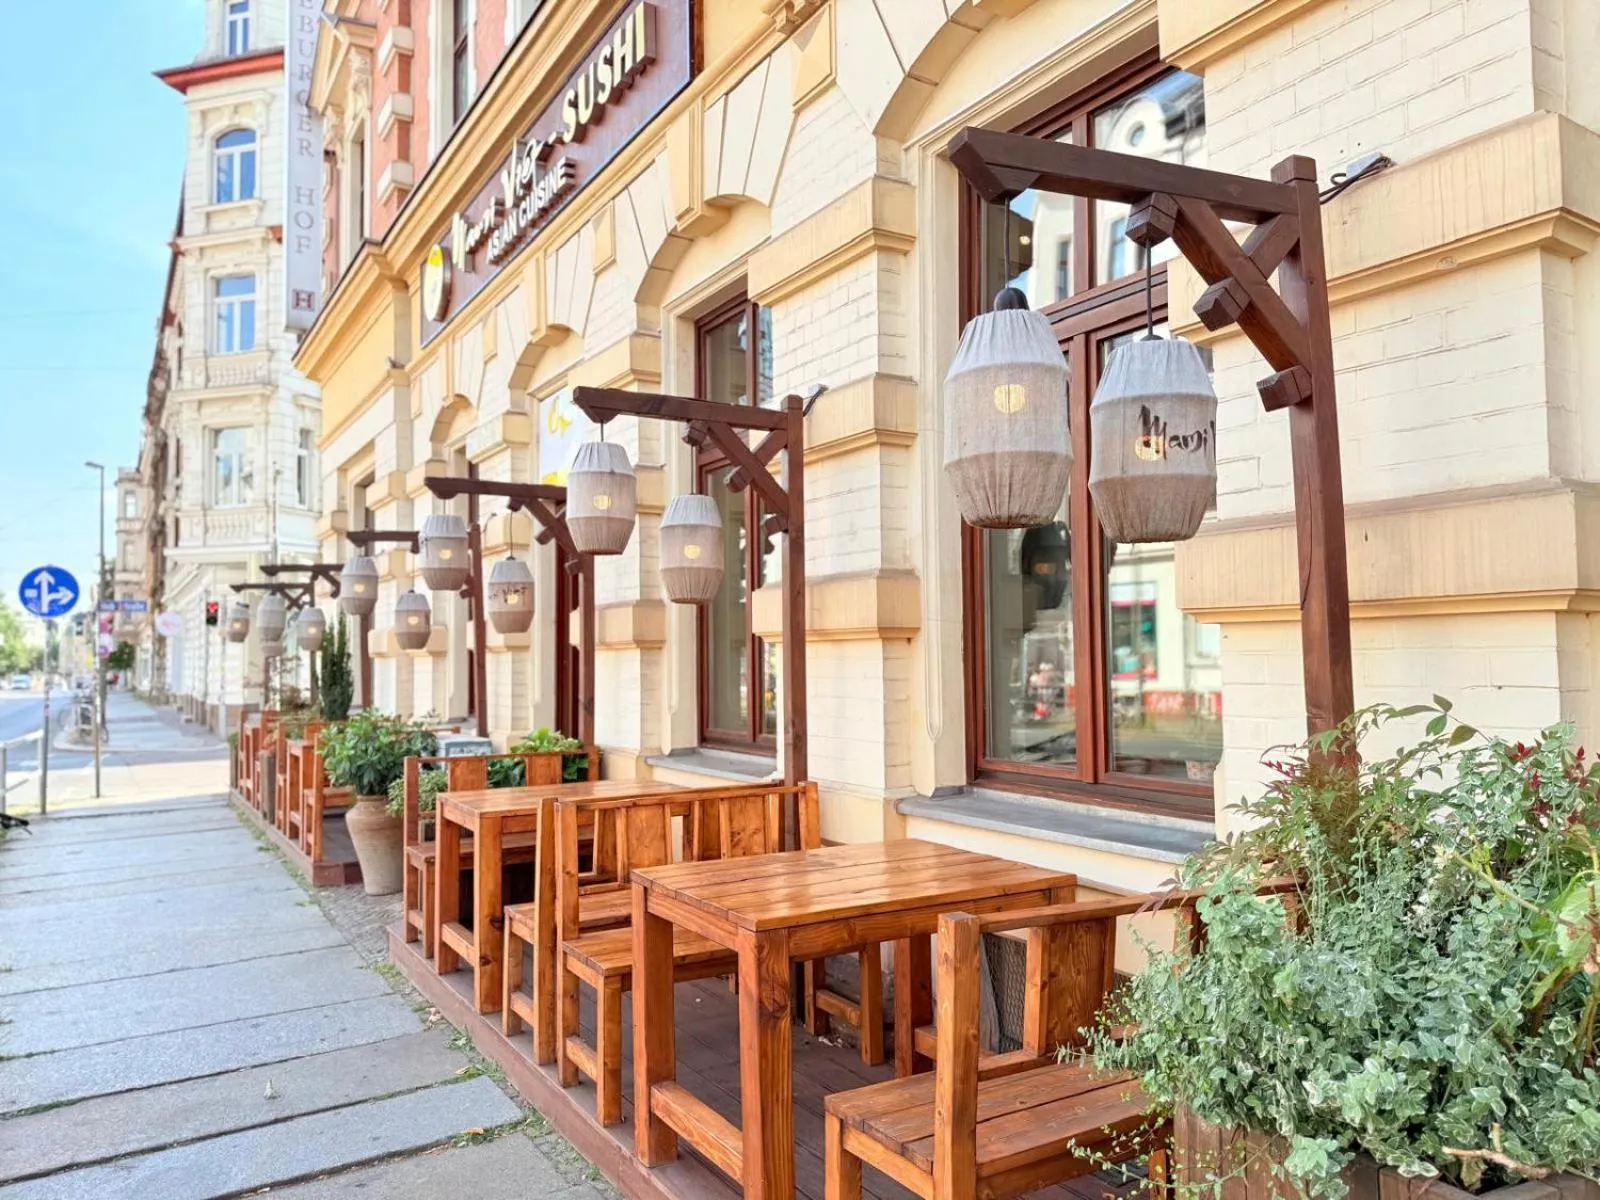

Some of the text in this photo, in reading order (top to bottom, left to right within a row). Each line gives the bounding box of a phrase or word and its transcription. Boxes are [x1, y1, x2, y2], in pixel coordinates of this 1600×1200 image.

[562, 1, 647, 143] SUSHI
[293, 185, 316, 254] HOF
[486, 155, 567, 264] ASIAN CUISINE
